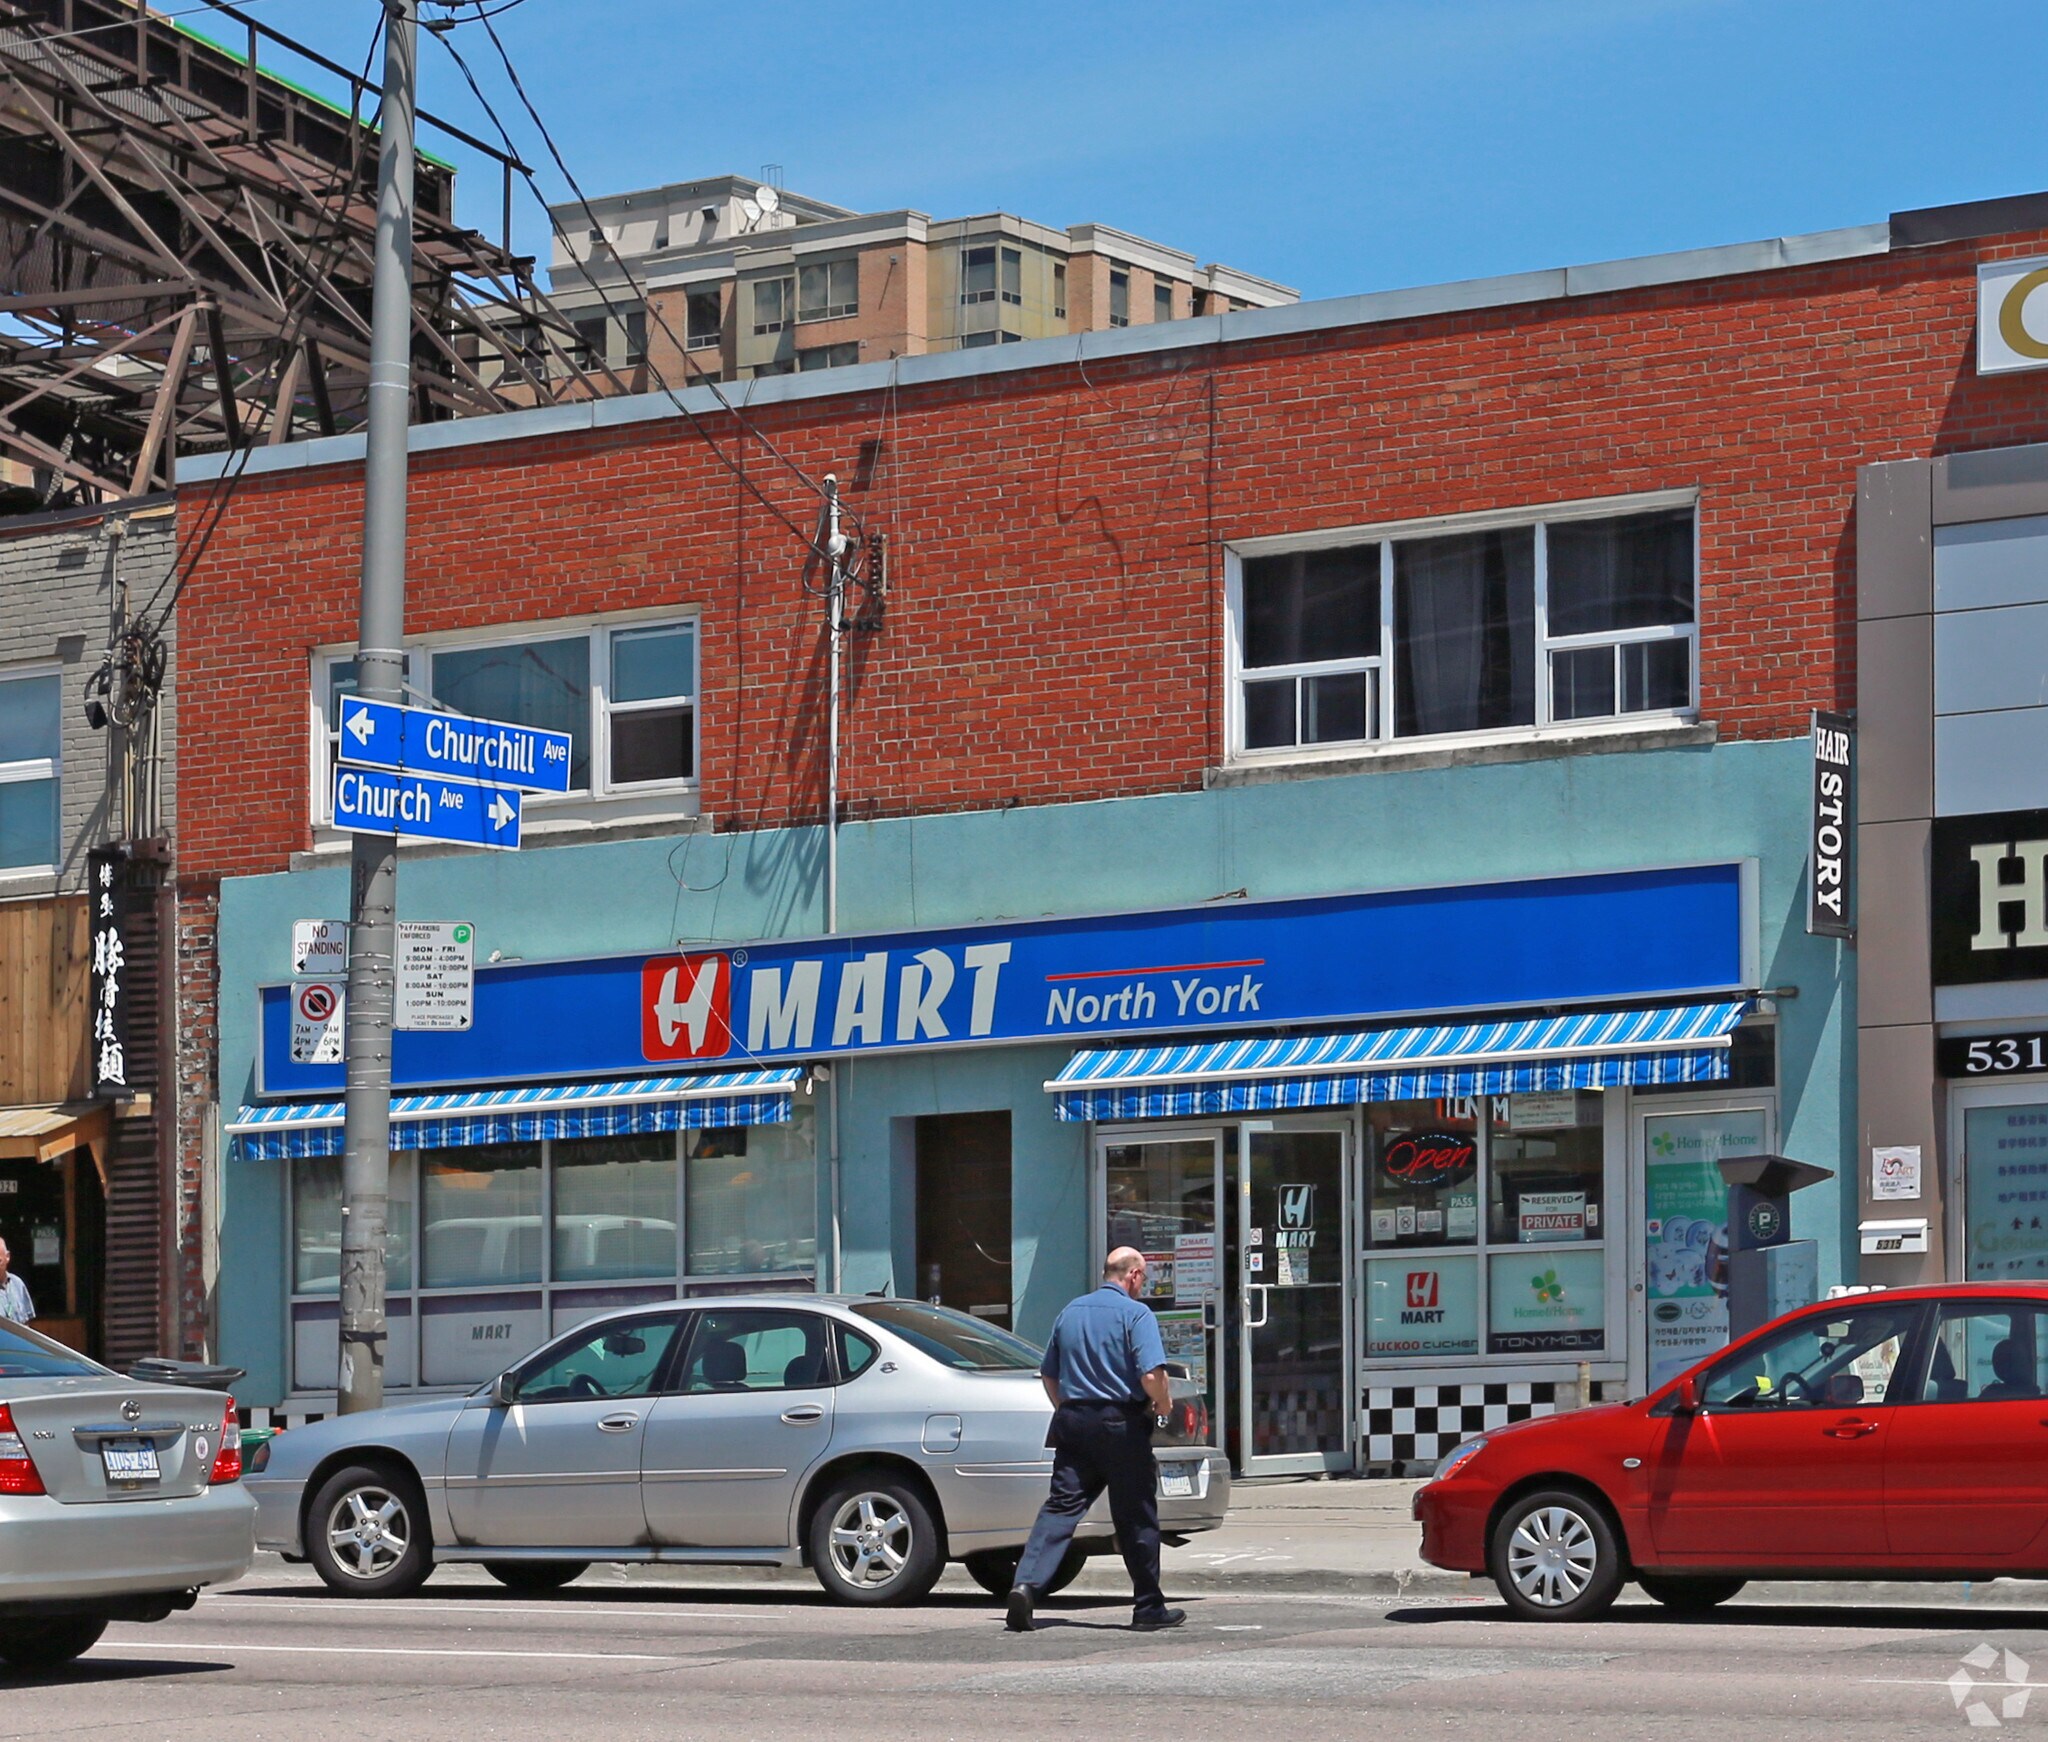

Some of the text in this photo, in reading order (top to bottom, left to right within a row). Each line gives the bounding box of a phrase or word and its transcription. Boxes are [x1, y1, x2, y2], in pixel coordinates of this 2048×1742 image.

[425, 719, 567, 774] Churchill Ave
[338, 773, 464, 823] Church Ave
[1815, 727, 1849, 916] HAIR STORY
[1970, 839, 2048, 951] H
[312, 925, 329, 939] NO
[297, 942, 343, 955] STANDING
[653, 956, 718, 1055] H
[747, 942, 1012, 1051] MART
[1046, 974, 1263, 1026] North York
[295, 1023, 311, 1034] 7AM
[323, 1023, 339, 1034] 9AM
[294, 1036, 311, 1046] 4PM
[323, 1036, 340, 1046] 6PM
[1386, 1141, 1472, 1177] Open
[1450, 1196, 1473, 1208] PASS
[1531, 1195, 1574, 1205] RESERVED
[1525, 1215, 1578, 1229] PRIVATE
[1276, 1231, 1317, 1248] MART
[1401, 1309, 1446, 1325] MART
[471, 1323, 512, 1340] MART
[1369, 1340, 1420, 1352] CUCKOO
[1495, 1334, 1602, 1349] TONYMOLY
